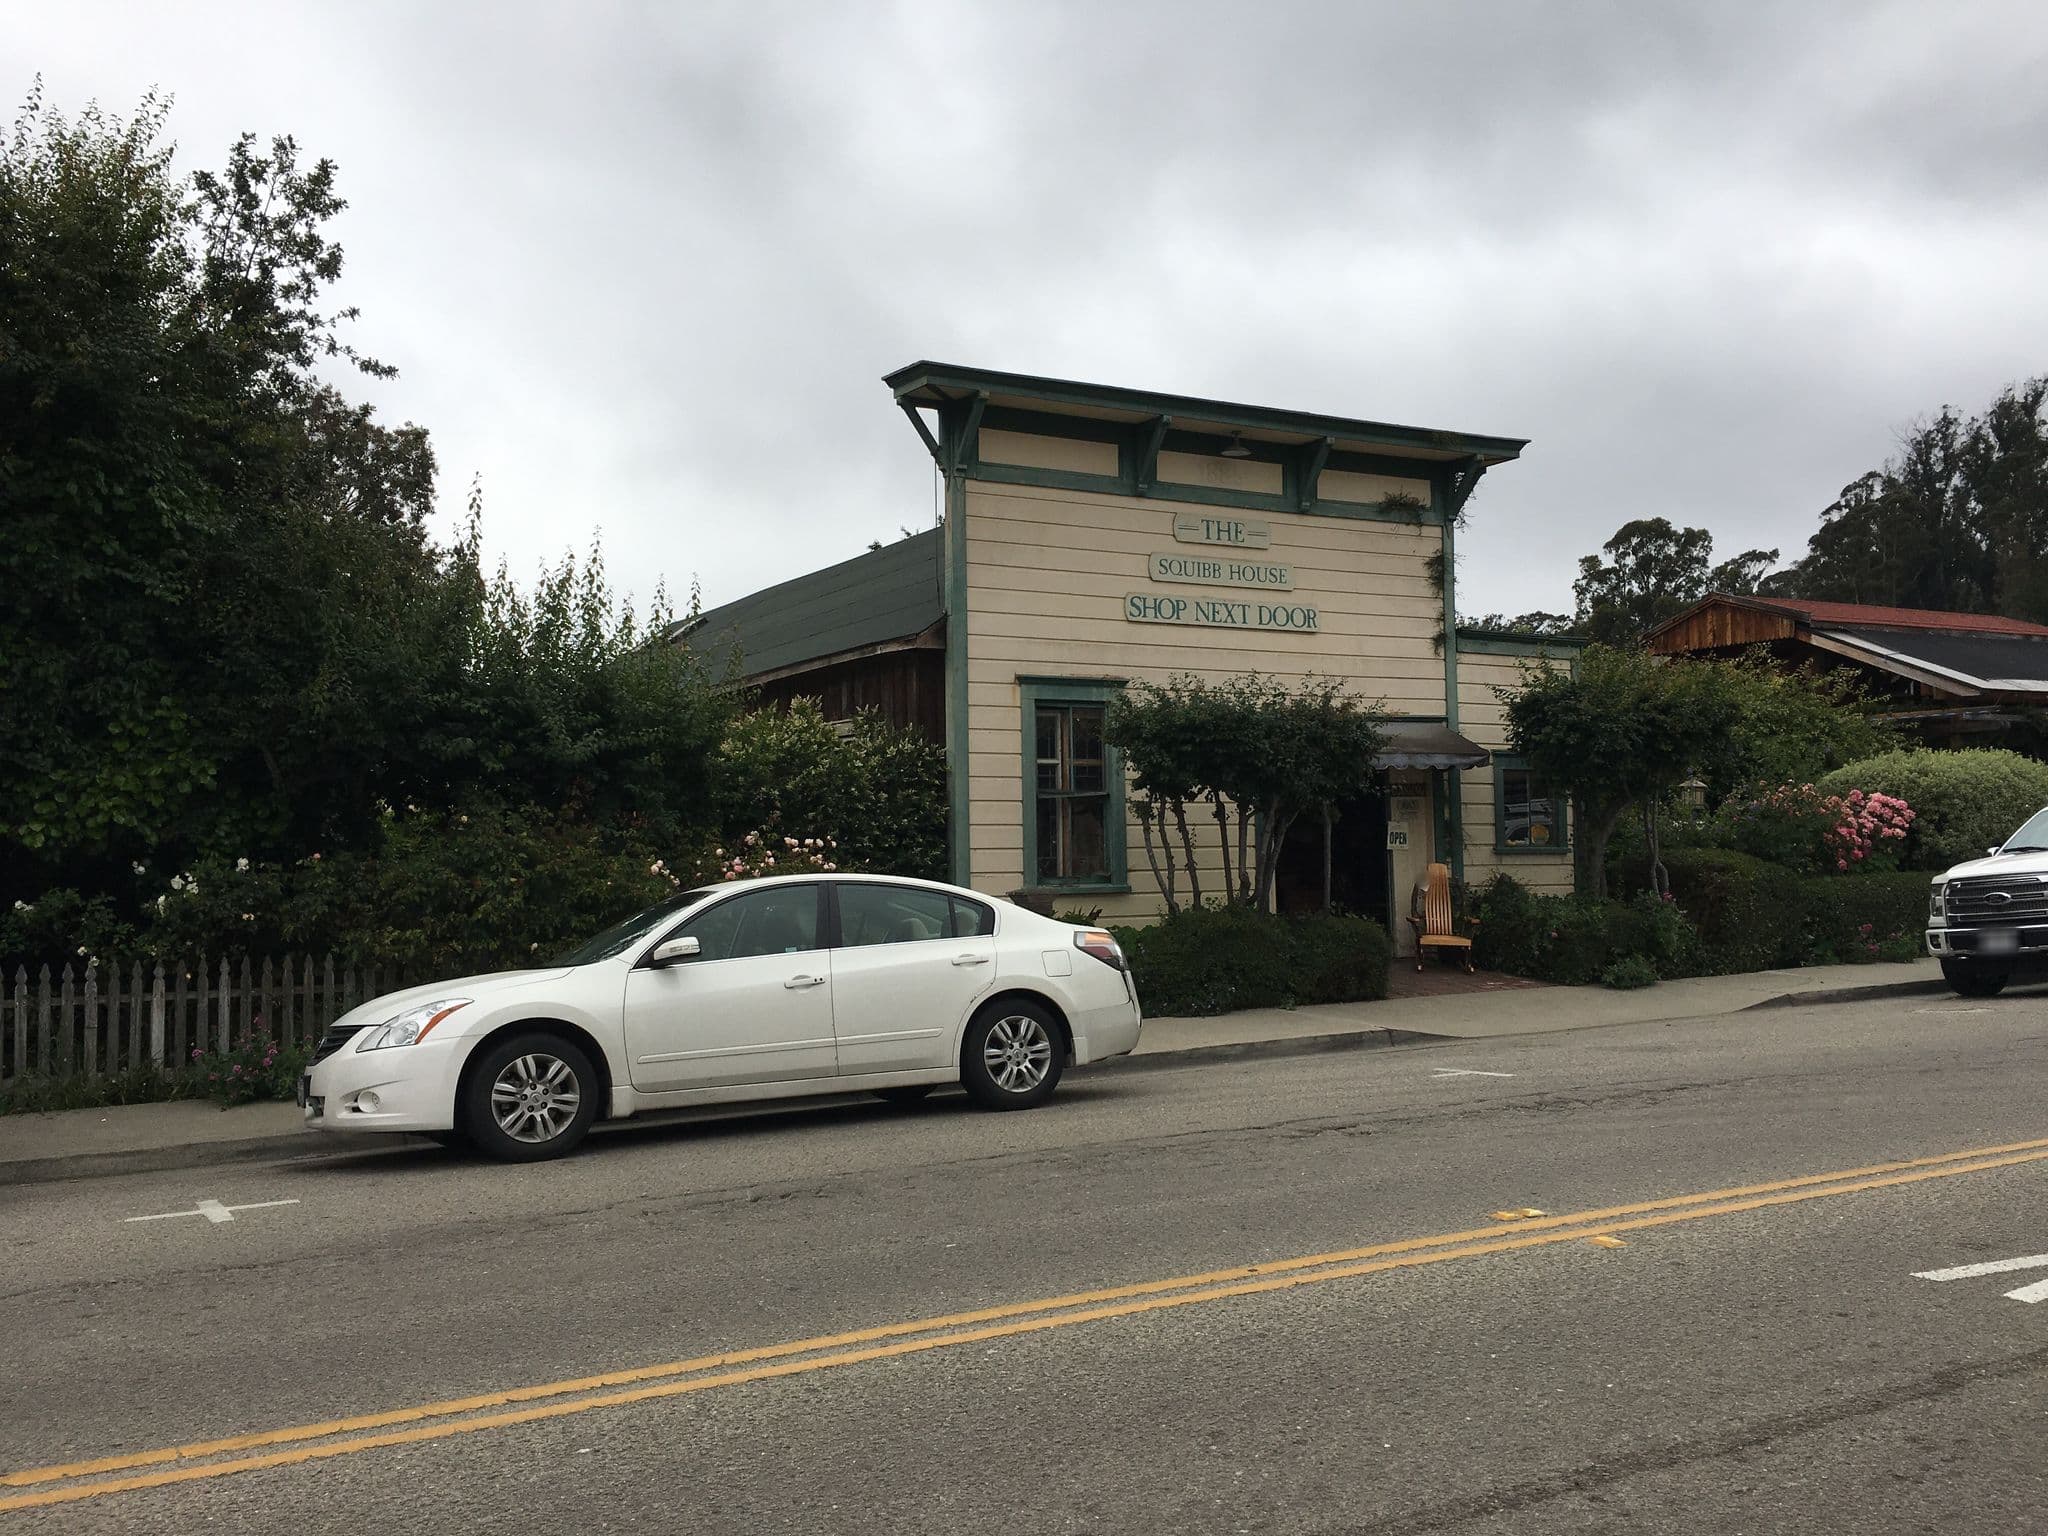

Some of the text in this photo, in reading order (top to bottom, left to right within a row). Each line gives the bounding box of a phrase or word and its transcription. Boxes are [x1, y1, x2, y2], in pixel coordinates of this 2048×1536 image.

[1201, 519, 1245, 543] THE
[1158, 558, 1287, 584] SQUIBB HOUSE
[1129, 595, 1318, 628] SHOP NEXT DOOR
[1389, 831, 1407, 845] OPEN
